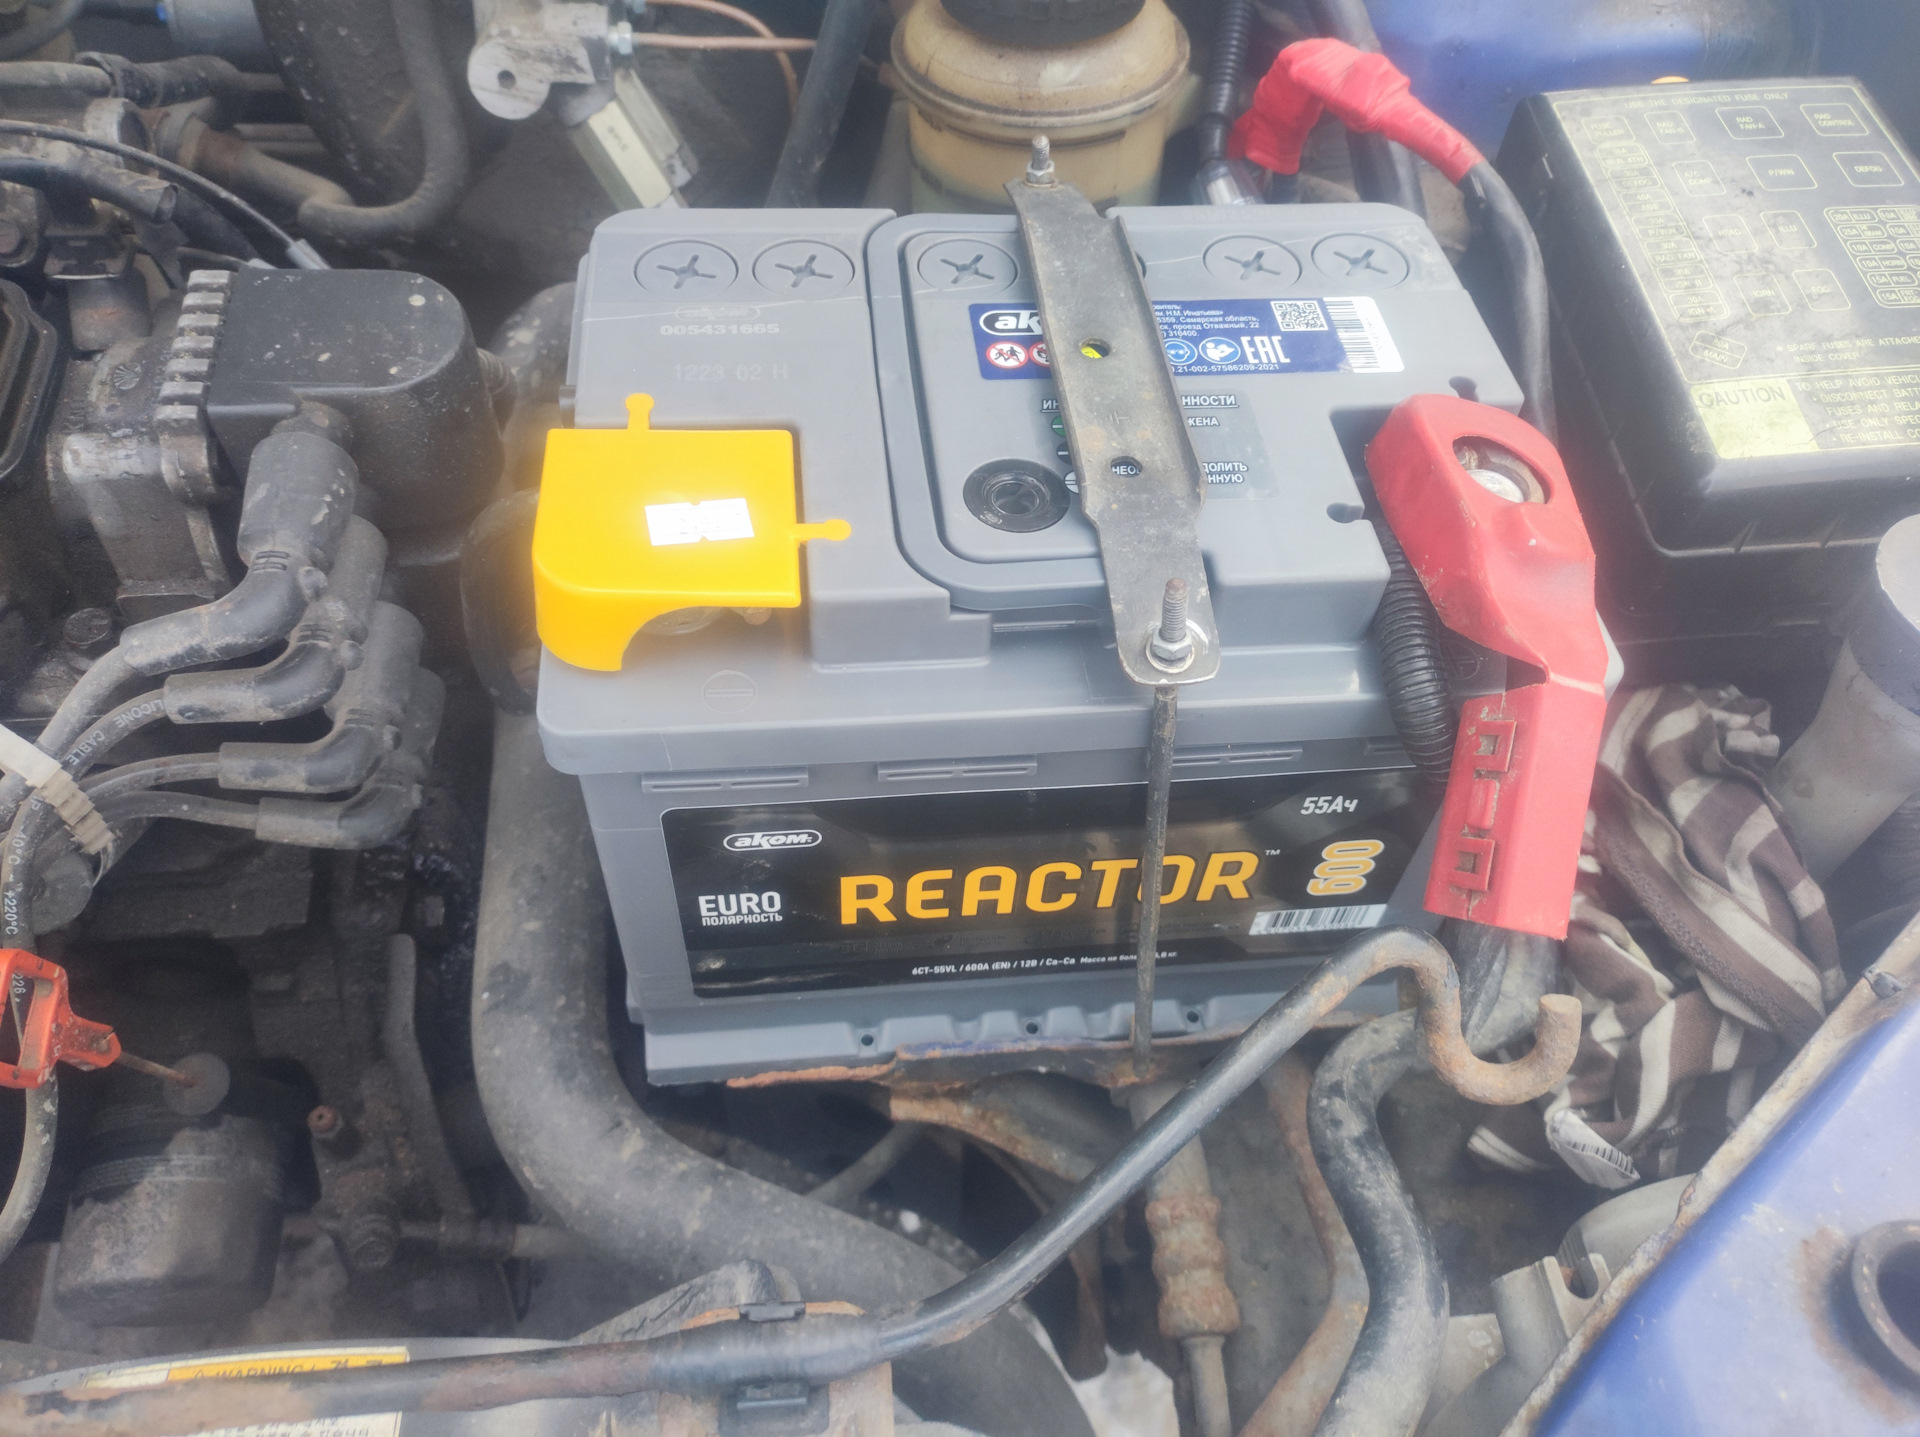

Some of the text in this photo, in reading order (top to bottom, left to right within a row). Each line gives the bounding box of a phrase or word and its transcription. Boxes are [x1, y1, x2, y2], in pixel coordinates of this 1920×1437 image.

[1764, 92, 1788, 100] ONLY
[1180, 316, 1224, 324] Самарская
[1203, 322, 1248, 330] Отважный,
[1250, 321, 1260, 329] 22
[660, 324, 779, 335] 005431665
[1821, 341, 1852, 349] FUSES
[1856, 339, 1875, 347] ARE
[1703, 350, 1729, 363] MAIN
[1794, 351, 1860, 363] INSIDE COVER
[1699, 386, 1787, 409] CAUTION
[1796, 382, 1810, 391] TO
[1817, 379, 1843, 390] HELP
[1849, 376, 1881, 387] AVOID
[1820, 389, 1888, 404] DISCONNECT
[1826, 404, 1863, 416] FUSES
[1868, 403, 1889, 413] AND
[1861, 417, 1889, 428] ONLY
[1841, 430, 1904, 443] RE-INSTALL
[66, 730, 105, 766] CABLE
[1300, 795, 1359, 815] 55Ач
[1306, 839, 1385, 896] 600
[840, 851, 1260, 926] REACTOR
[698, 890, 782, 917] EURO
[702, 912, 783, 926] ПОЛЯРНОСТЬ
[992, 961, 1011, 970] (EN)
[1080, 955, 1106, 964] Масса
